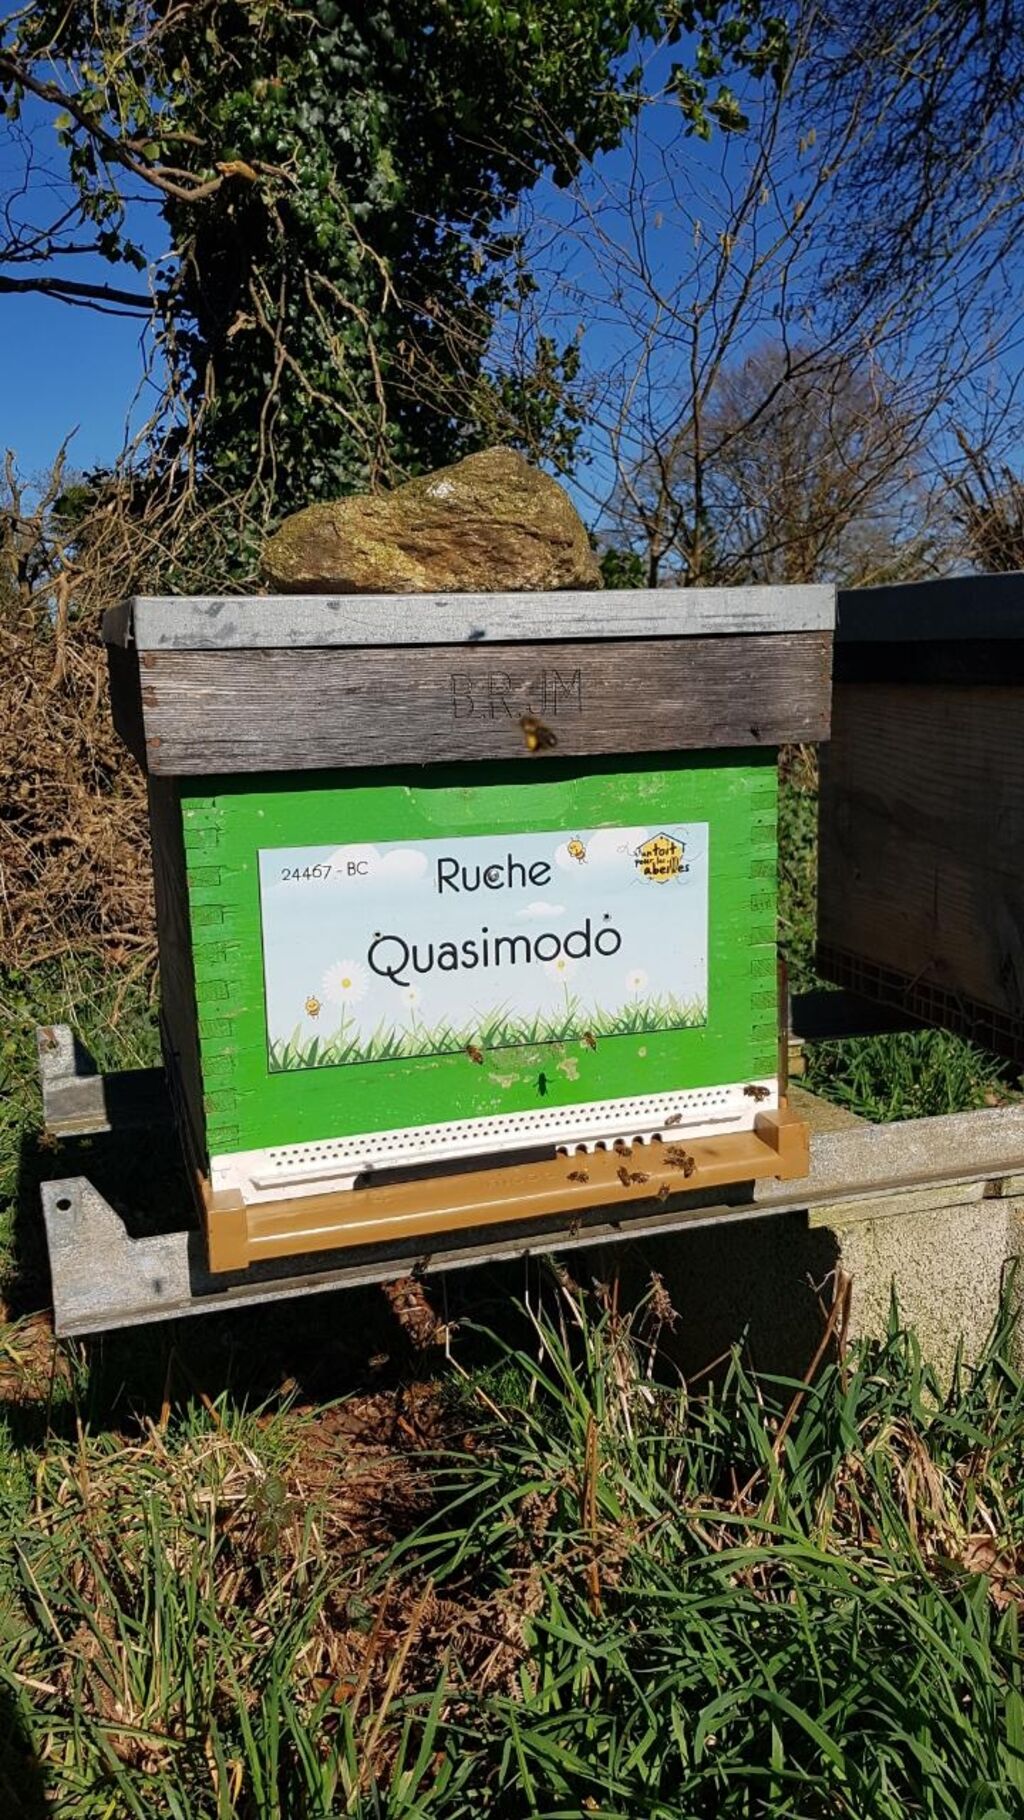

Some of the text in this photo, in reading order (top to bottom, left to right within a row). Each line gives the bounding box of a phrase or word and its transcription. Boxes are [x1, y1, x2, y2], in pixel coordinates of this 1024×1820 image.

[281, 864, 332, 881] 24467
[347, 861, 369, 877] BC
[437, 853, 551, 894] Ruche
[367, 918, 622, 987] Quasimodo
